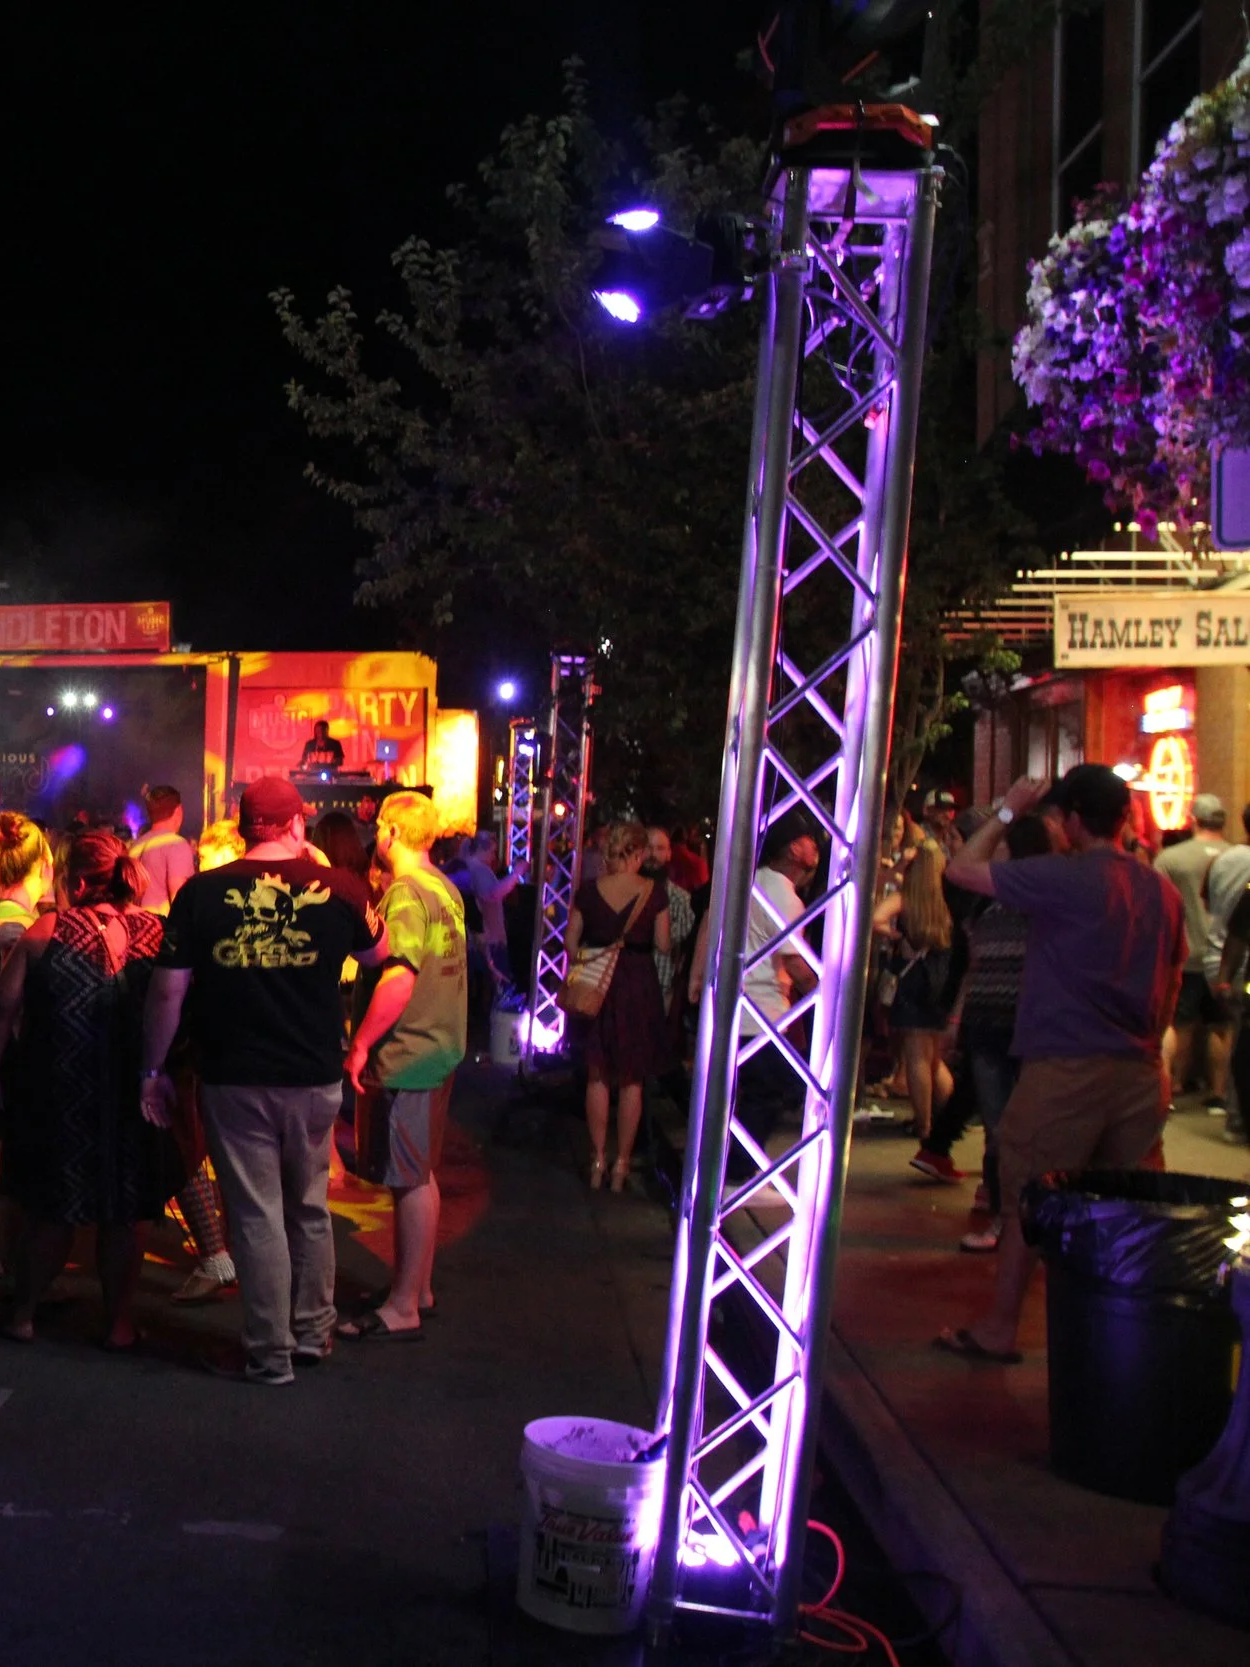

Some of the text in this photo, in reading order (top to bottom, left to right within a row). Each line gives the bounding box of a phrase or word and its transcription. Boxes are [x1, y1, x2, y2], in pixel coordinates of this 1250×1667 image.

[253, 710, 308, 728] MUSIC
[329, 690, 419, 727] PARTY
[352, 728, 381, 762] IN
